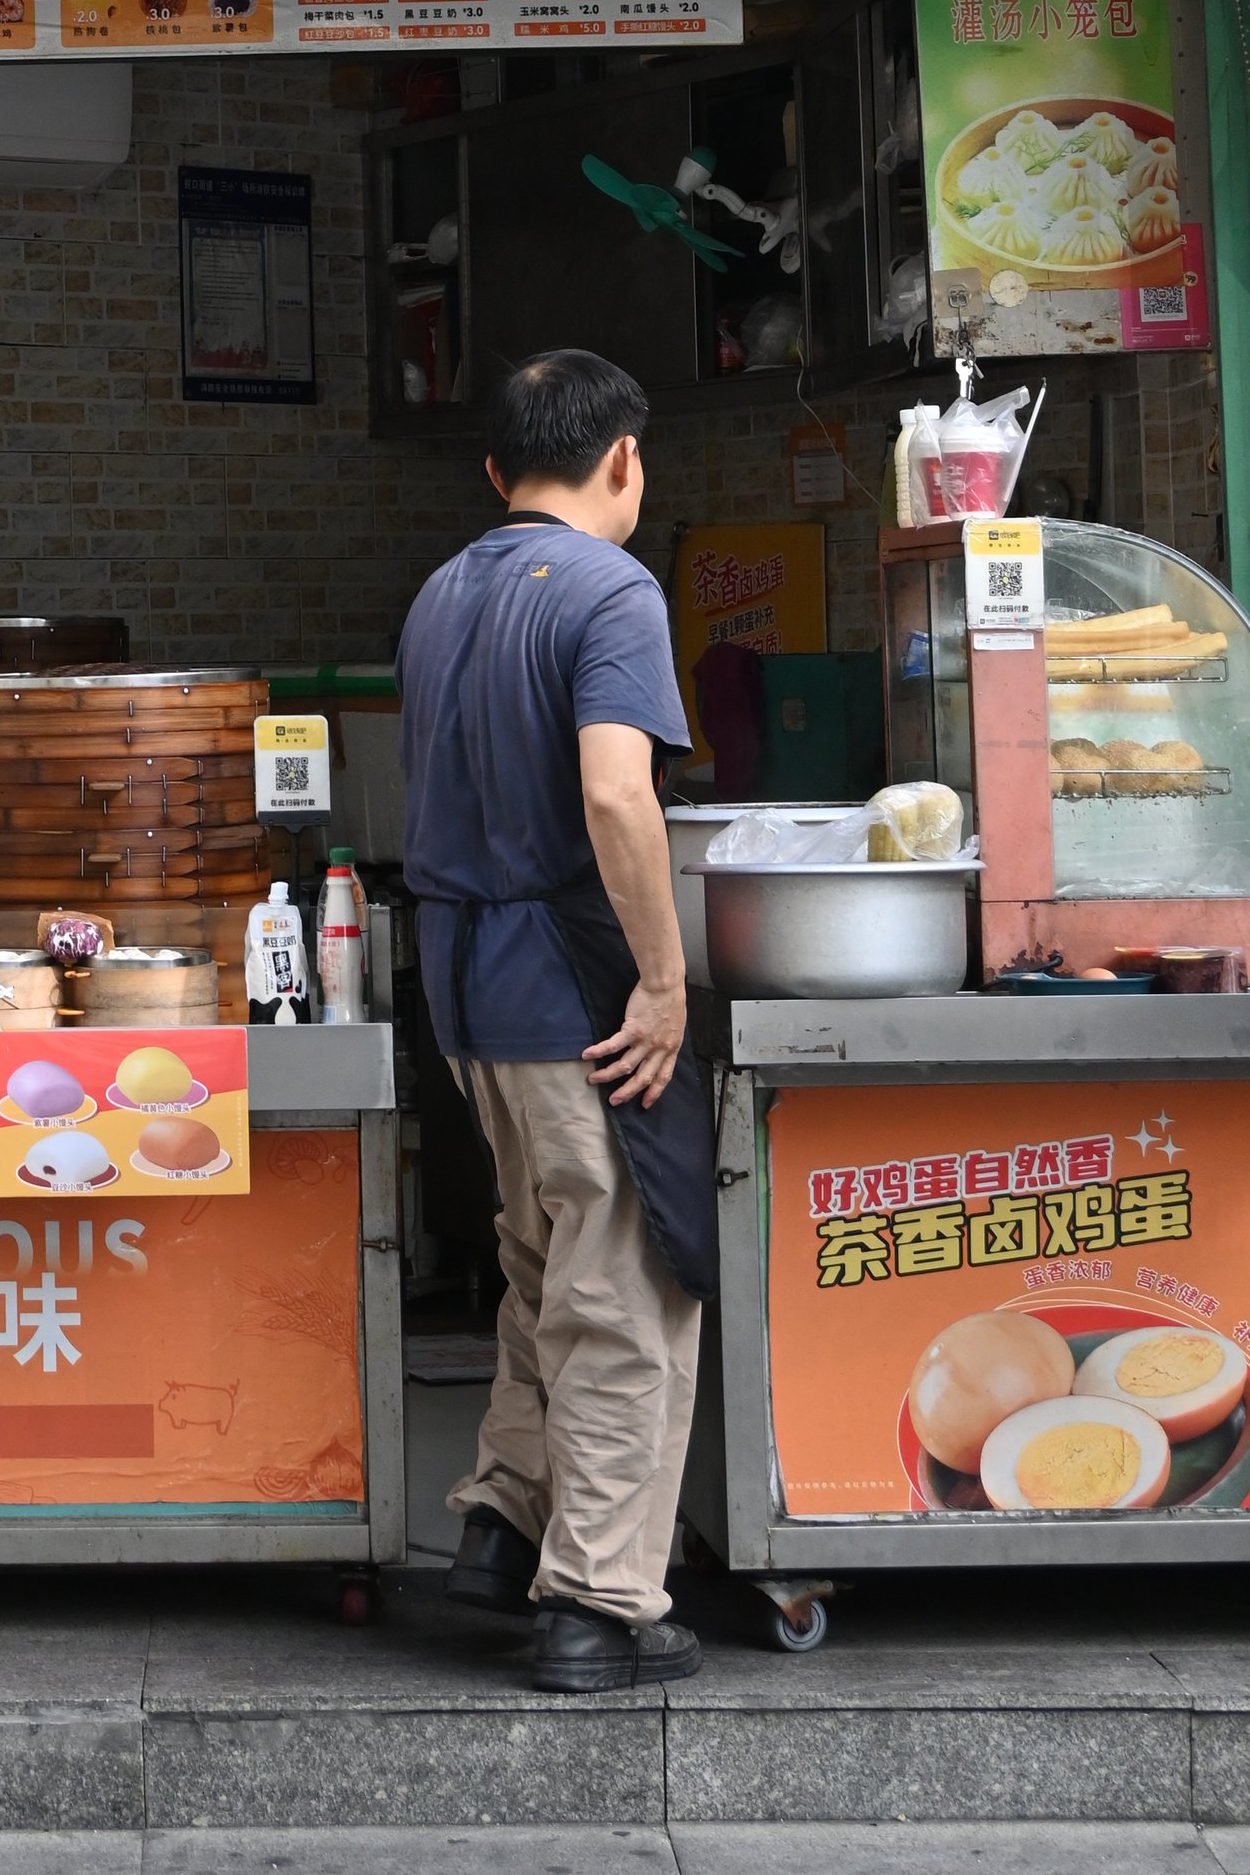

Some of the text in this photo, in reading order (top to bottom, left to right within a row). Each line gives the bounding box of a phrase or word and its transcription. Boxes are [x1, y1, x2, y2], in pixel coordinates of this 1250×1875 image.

[404, 8, 457, 19] 黑豆豆奶
[519, 5, 570, 16] 玉米窝窝头
[304, 11, 355, 22] 梅干菜肉包
[691, 549, 785, 609] 茶香卤鸡蛋
[982, 604, 1030, 613] 在此扫码付款
[270, 798, 317, 807] 在此扫码付款
[809, 1134, 1114, 1218] 好鸡蛋自然香
[816, 1169, 1192, 1288] 茶香卤鸡蛋
[1024, 1258, 1221, 1318] 蛋香浓郁 营养健康
